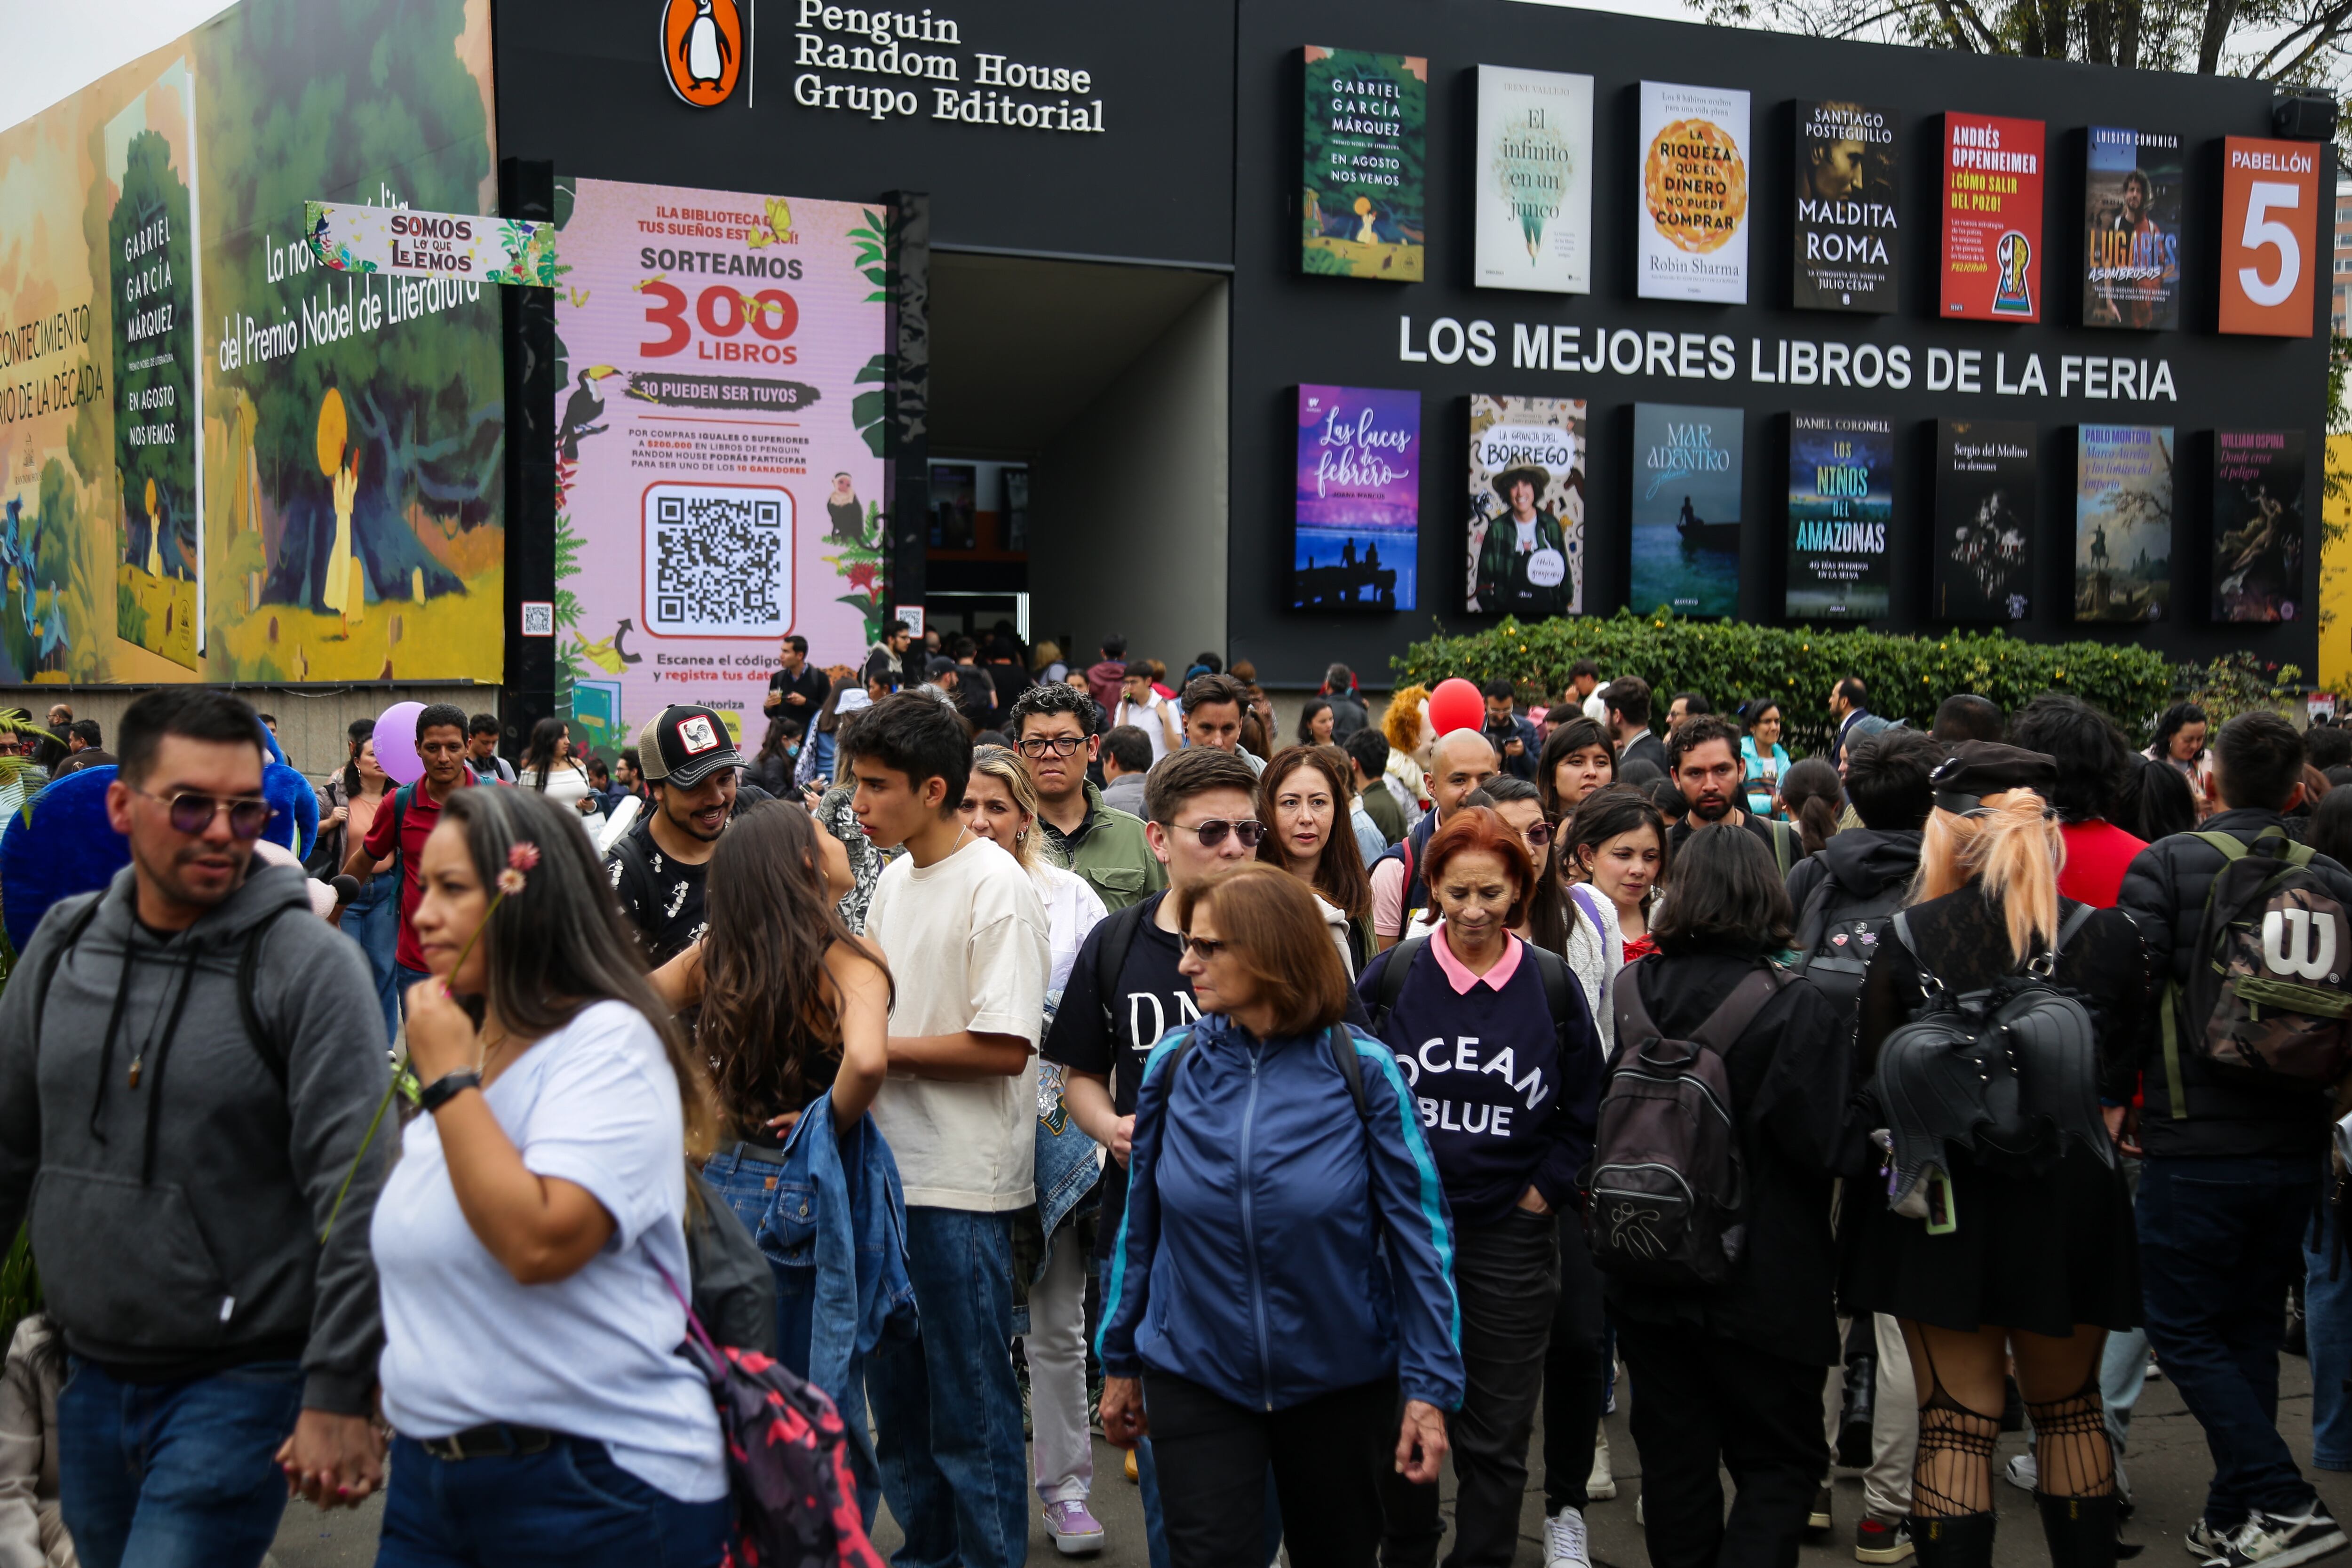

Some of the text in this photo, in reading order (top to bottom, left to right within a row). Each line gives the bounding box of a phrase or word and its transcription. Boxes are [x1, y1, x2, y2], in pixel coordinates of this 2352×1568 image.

[796, 0, 961, 45] Penguin
[795, 33, 1092, 94] Random House
[1331, 79, 1401, 99] GABRIEL
[1662, 92, 1675, 101] Los
[1708, 96, 1732, 107] ocultos
[794, 73, 1105, 133] Grupo Editorial
[1331, 97, 1401, 118] GARCÍA
[1665, 105, 1679, 113] para
[1695, 106, 1709, 116] vida
[1711, 106, 1729, 117] plena
[1332, 116, 1400, 137] MÁRQUEZ
[1528, 108, 1545, 129] El
[1814, 107, 1883, 128] SANTIAGO
[1690, 130, 1703, 140] LA
[1806, 121, 1892, 143] POSTEGUILLO
[1952, 123, 2000, 150] ANDRÉS
[2135, 132, 2177, 149] COMUNICA
[1504, 137, 1569, 163] infinito
[1661, 143, 1732, 162] RIQUEZA
[1952, 147, 2037, 175] OPPENHEIMER
[1331, 153, 1399, 170] EN AGOSTO
[1676, 162, 1717, 175] QUE EL
[2232, 150, 2311, 174] PABELLÓN
[1331, 170, 1399, 186] NOS VEMOS
[1510, 173, 1559, 190] en un
[1665, 177, 1727, 196] DINERO
[1988, 175, 2018, 194] SALIR
[1508, 197, 1560, 221] junco
[1667, 198, 1724, 210] NO PUEDE
[1798, 197, 1898, 229] MALDITA
[1951, 191, 2001, 213] DEL POZO!
[657, 206, 760, 226] ¡LA BIBLIOTECA
[1656, 211, 1734, 230] COMPRAR
[391, 215, 472, 241] SOMOS
[638, 221, 723, 238] TUS SUEÑOS
[126, 216, 171, 263] GABRIEL
[414, 239, 452, 252] LO QUE
[1806, 231, 1889, 265] ROMA
[2090, 228, 2176, 269] LUGARES
[2239, 180, 2300, 307] 5
[267, 235, 285, 284] La
[392, 239, 472, 272] LEEMOS
[641, 247, 803, 280] SORTEAMOS
[1650, 255, 1739, 276] Robin Sharma
[127, 256, 173, 302] GARCÍA
[128, 304, 173, 342] MÁRQUEZ
[220, 273, 480, 372] del Premio Nobel de Literatura
[640, 280, 799, 358] 300
[0, 304, 90, 369] ONTECIMIENTO
[699, 341, 797, 366] LIBROS
[1400, 315, 2177, 402] LOS MEJORES LIBROS DE LA FERIA
[19, 361, 105, 421] DE LA DÉCADA
[129, 384, 175, 411] EN AGOSTO
[640, 381, 797, 403] 30 PUEDEN SER TUYOS
[130, 422, 175, 446] NOS VEMOS
[1319, 405, 1412, 454] Las luces
[1668, 422, 1712, 449] MAR
[1796, 416, 1890, 433] DANIEL CORONELL
[648, 441, 692, 449] $200.000
[710, 444, 743, 452] LIBROS
[760, 446, 800, 454] PENGUIN
[651, 430, 696, 439] COMPRAS
[699, 433, 739, 442] IGUALES
[752, 435, 810, 445] SUPERIORES
[1499, 429, 1558, 444] LA GRANJA DEL
[2085, 429, 2151, 445] PABLO MONTOYA
[2221, 432, 2254, 448] WILLIAM
[632, 450, 806, 464] RANDOM HOUSE PODRÁS PARTICIPAR
[1359, 445, 1383, 468] de
[1487, 443, 1568, 466] BORREGO
[1834, 441, 1851, 459] LOS
[1954, 442, 2028, 460] Sergio del Molino
[750, 466, 806, 475] GANADORES
[1314, 445, 1409, 499] febrero
[1817, 462, 1868, 498] NIÑOS
[1833, 500, 1850, 518] DEL
[1796, 519, 1885, 554] AMAZONAS
[657, 654, 781, 668] Escanea el código
[654, 670, 743, 683] y registra tus
[696, 700, 744, 710] Autoriza
[1128, 991, 1203, 1050] DN
[1396, 1036, 1549, 1110] OCEAN
[1418, 1097, 1513, 1137] BLUE
